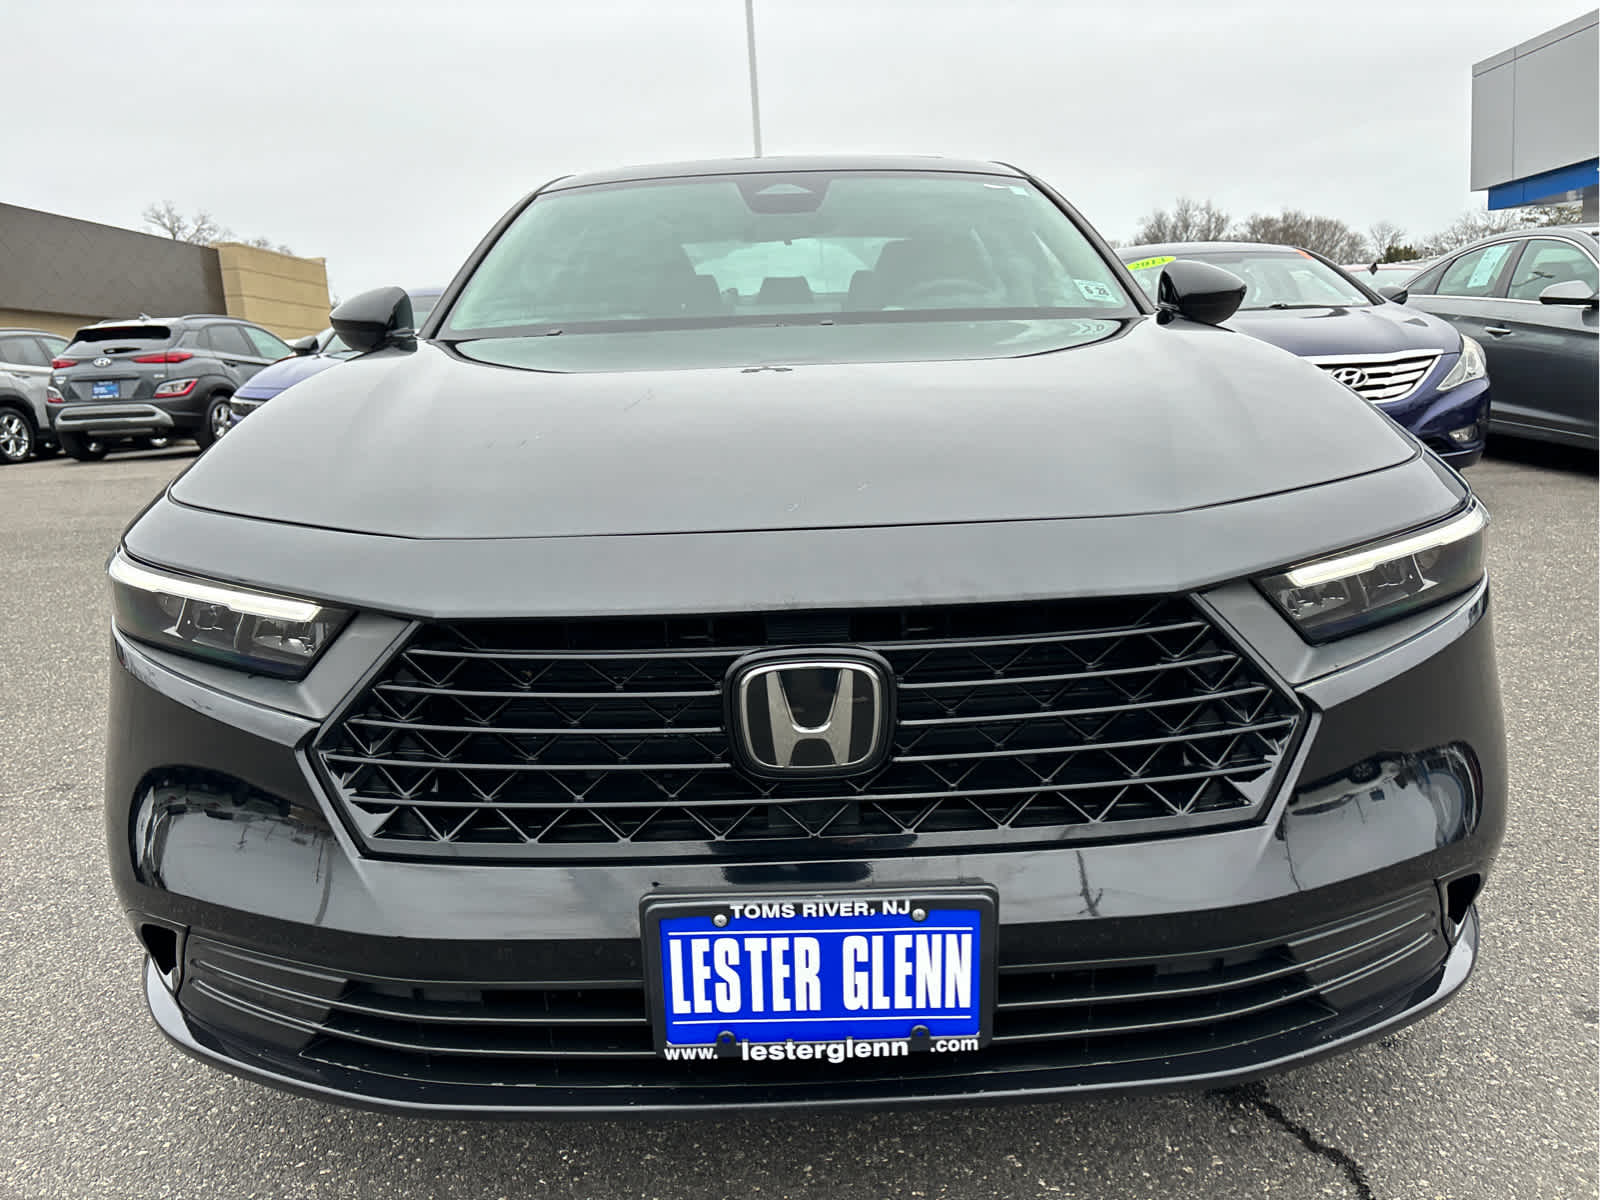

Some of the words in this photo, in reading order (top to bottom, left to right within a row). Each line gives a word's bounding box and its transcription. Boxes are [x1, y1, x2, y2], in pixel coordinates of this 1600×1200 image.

[730, 903, 796, 919] TOMS
[802, 900, 876, 918] RIVER,
[882, 899, 911, 916] NJ
[669, 936, 822, 1015] LESTER
[842, 933, 973, 1011] GLENN
[664, 1047, 719, 1061] www.
[741, 1038, 909, 1064] lesterglenn
[930, 1037, 979, 1053] .com
